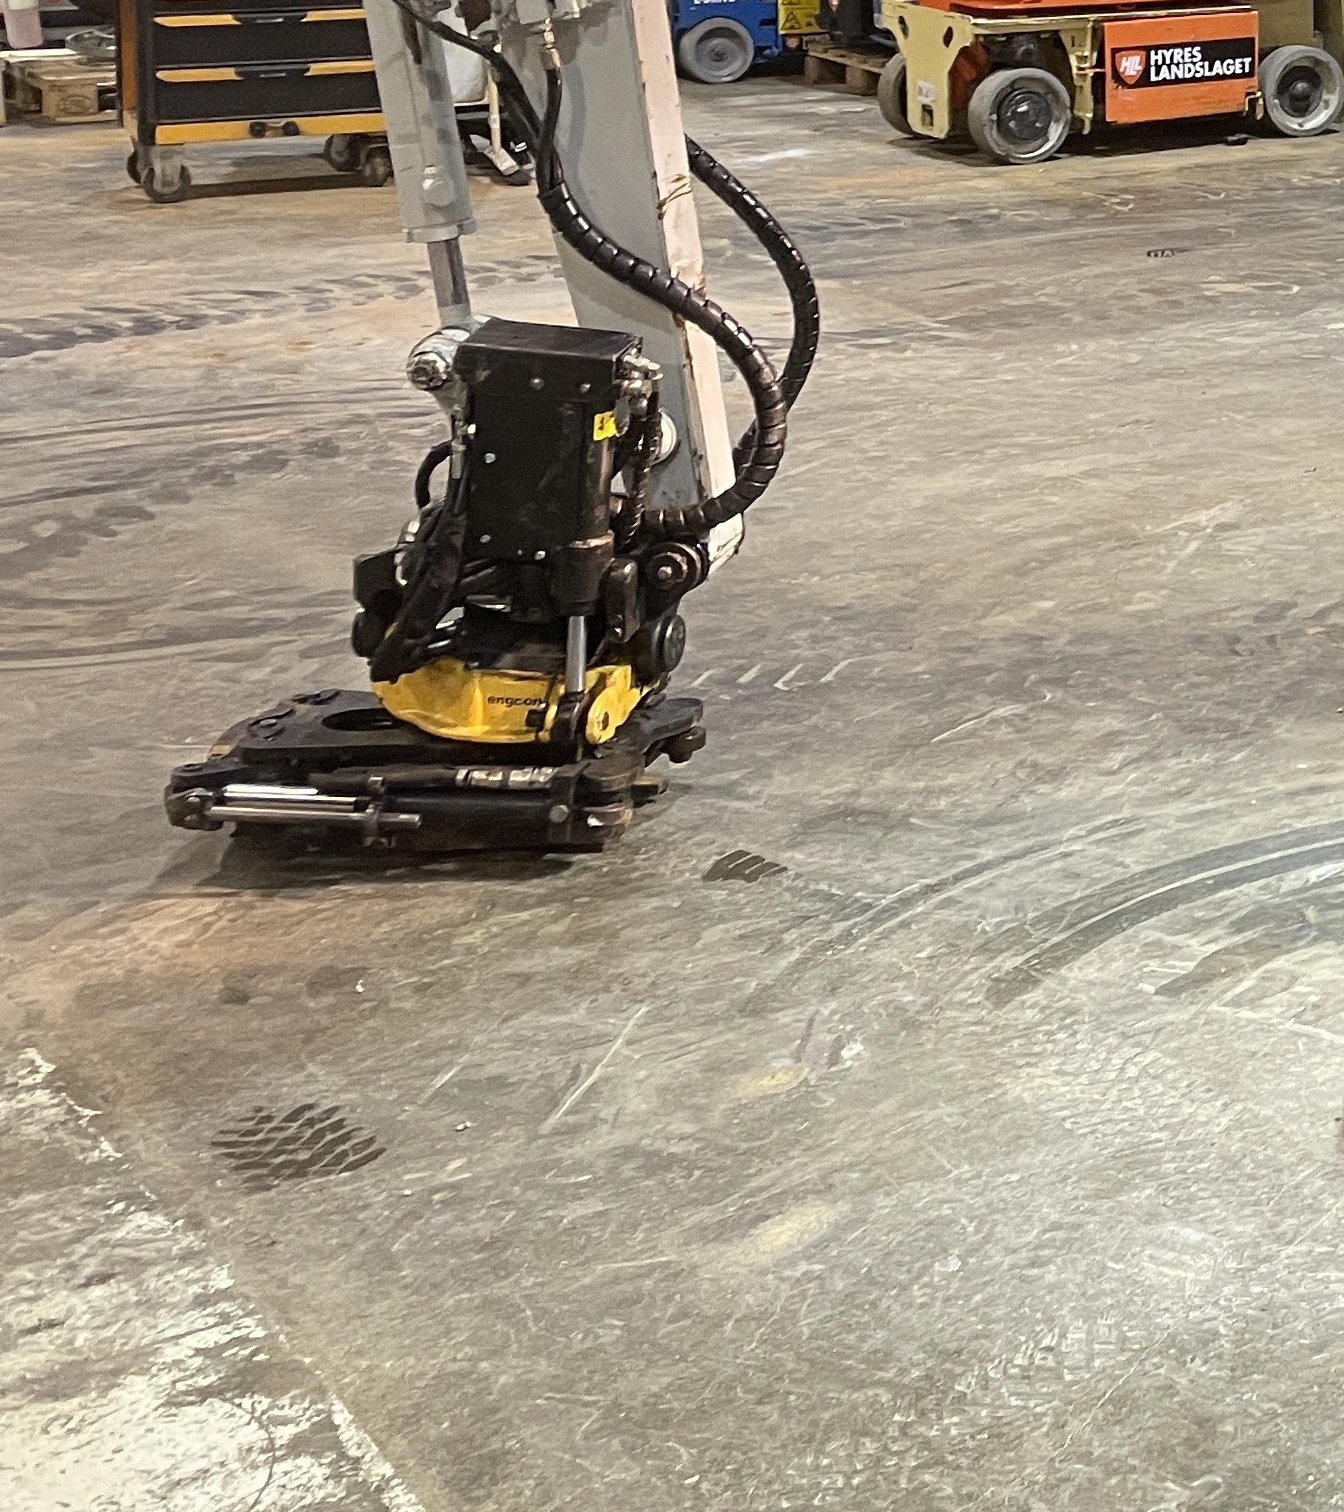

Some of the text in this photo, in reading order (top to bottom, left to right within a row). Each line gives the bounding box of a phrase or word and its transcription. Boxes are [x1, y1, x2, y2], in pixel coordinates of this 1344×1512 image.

[1150, 46, 1202, 66] HYRES
[1150, 57, 1252, 82] LANDSLAGET
[487, 695, 543, 708] engcon
